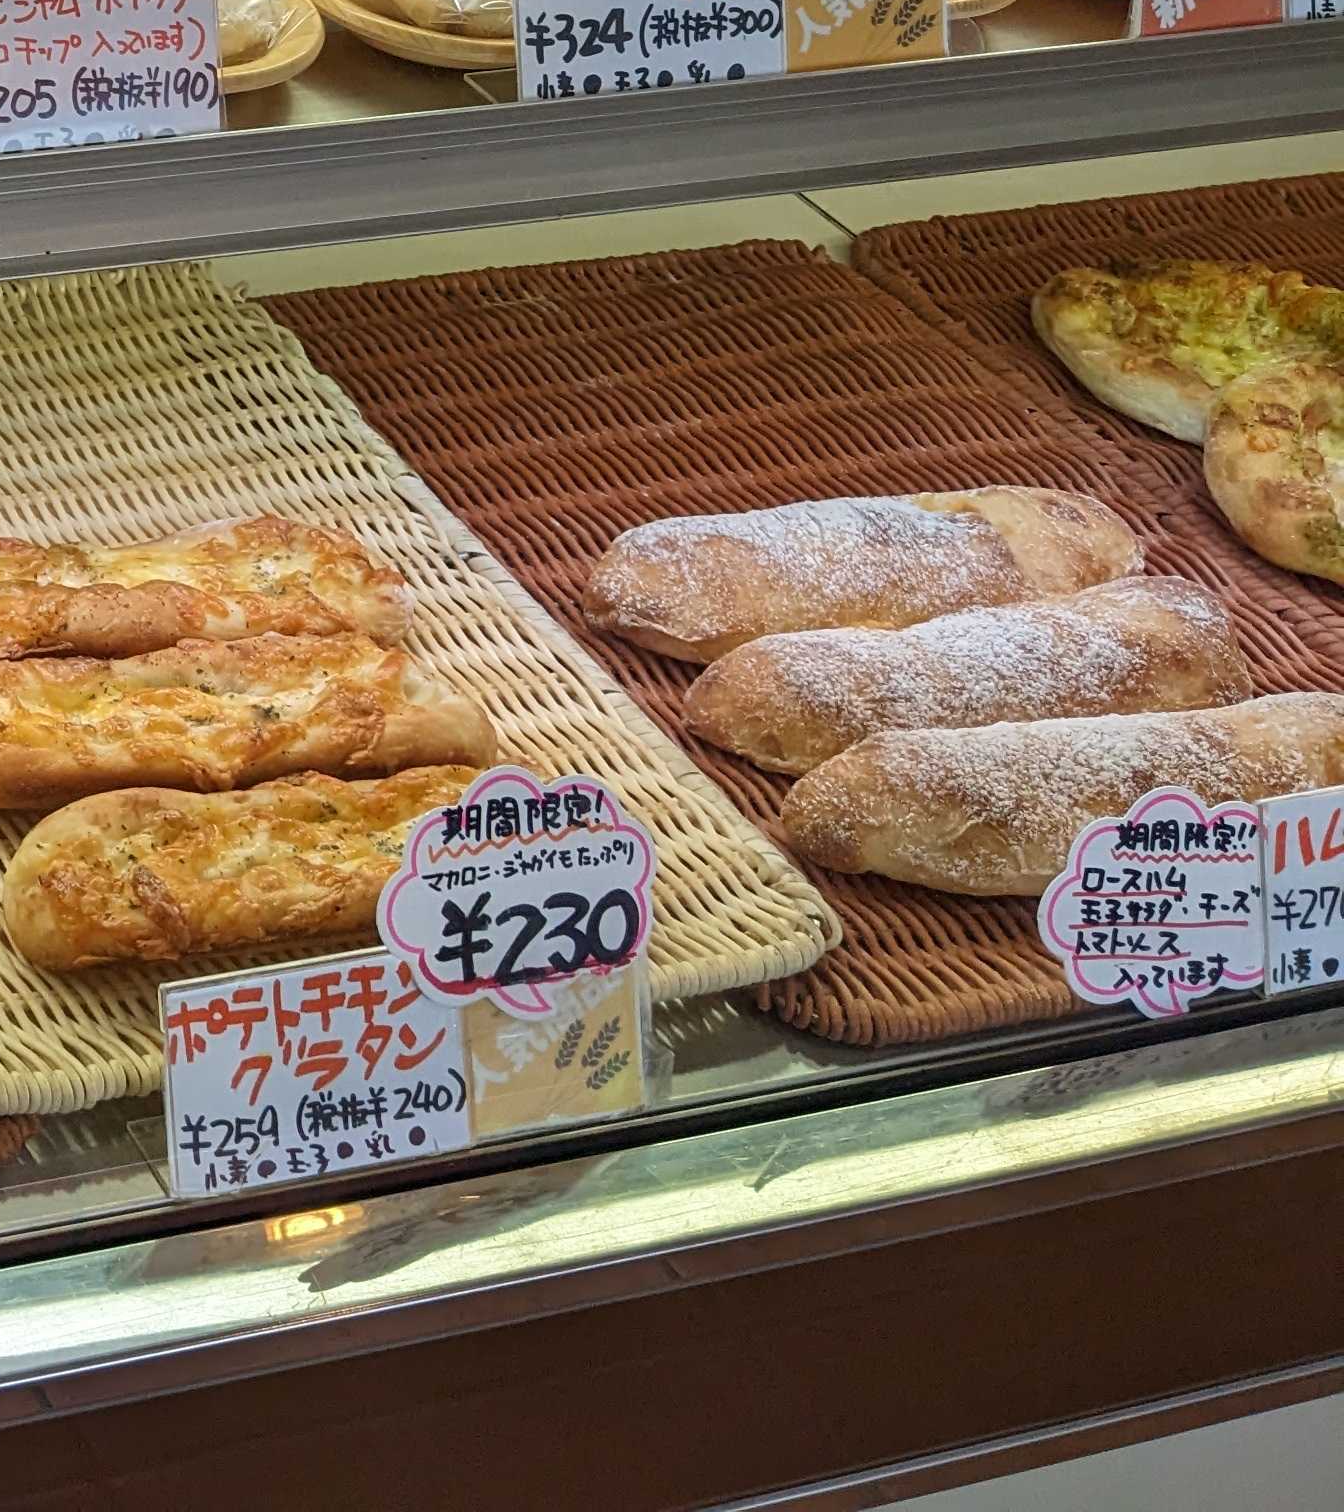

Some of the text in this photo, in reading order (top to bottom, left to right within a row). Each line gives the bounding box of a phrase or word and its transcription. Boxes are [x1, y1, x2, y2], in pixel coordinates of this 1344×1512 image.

[525, 7, 634, 65] ¥324
[442, 785, 604, 844] 期間限定!
[1081, 866, 1186, 893] ロースハム
[435, 889, 640, 985] ¥230
[1272, 886, 1344, 932] ¥27
[1113, 953, 1229, 988] 入っています
[231, 1022, 446, 1106] グラタン
[180, 1104, 278, 1165] ¥259
